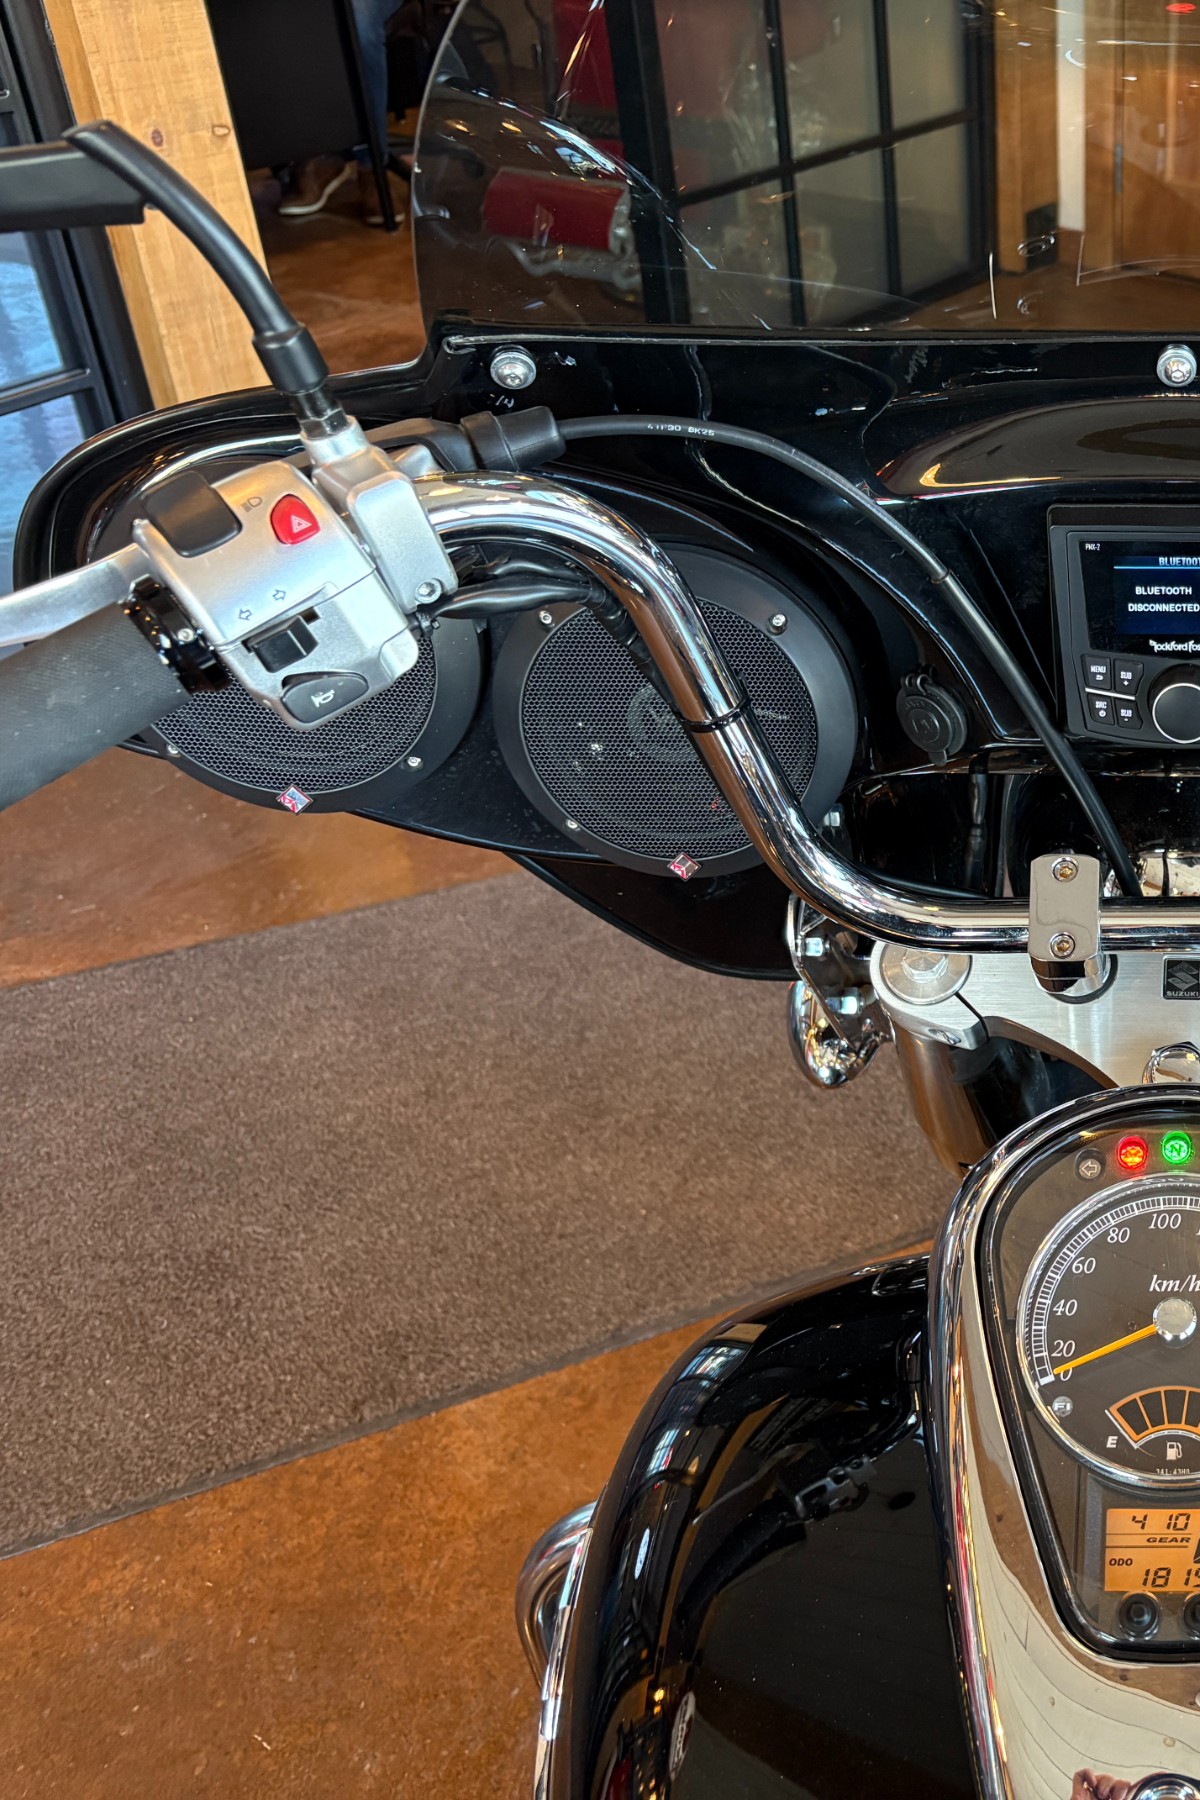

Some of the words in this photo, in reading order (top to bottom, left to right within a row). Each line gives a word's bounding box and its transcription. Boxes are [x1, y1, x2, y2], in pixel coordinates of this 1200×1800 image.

[1135, 586, 1193, 595] BLUETOOTH
[1127, 603, 1200, 613] DISCONNECTED
[1090, 665, 1107, 674] MENU
[1120, 671, 1132, 680] SUB
[1120, 709, 1133, 718] SUB
[1148, 1213, 1182, 1230] 100
[1107, 1227, 1130, 1243] 80
[1072, 1257, 1096, 1274] 60
[1053, 1299, 1078, 1317] 40
[1051, 1340, 1076, 1358] 20
[1054, 1402, 1071, 1411] FI
[1106, 1436, 1118, 1448] E
[1109, 1558, 1133, 1566] ODO
